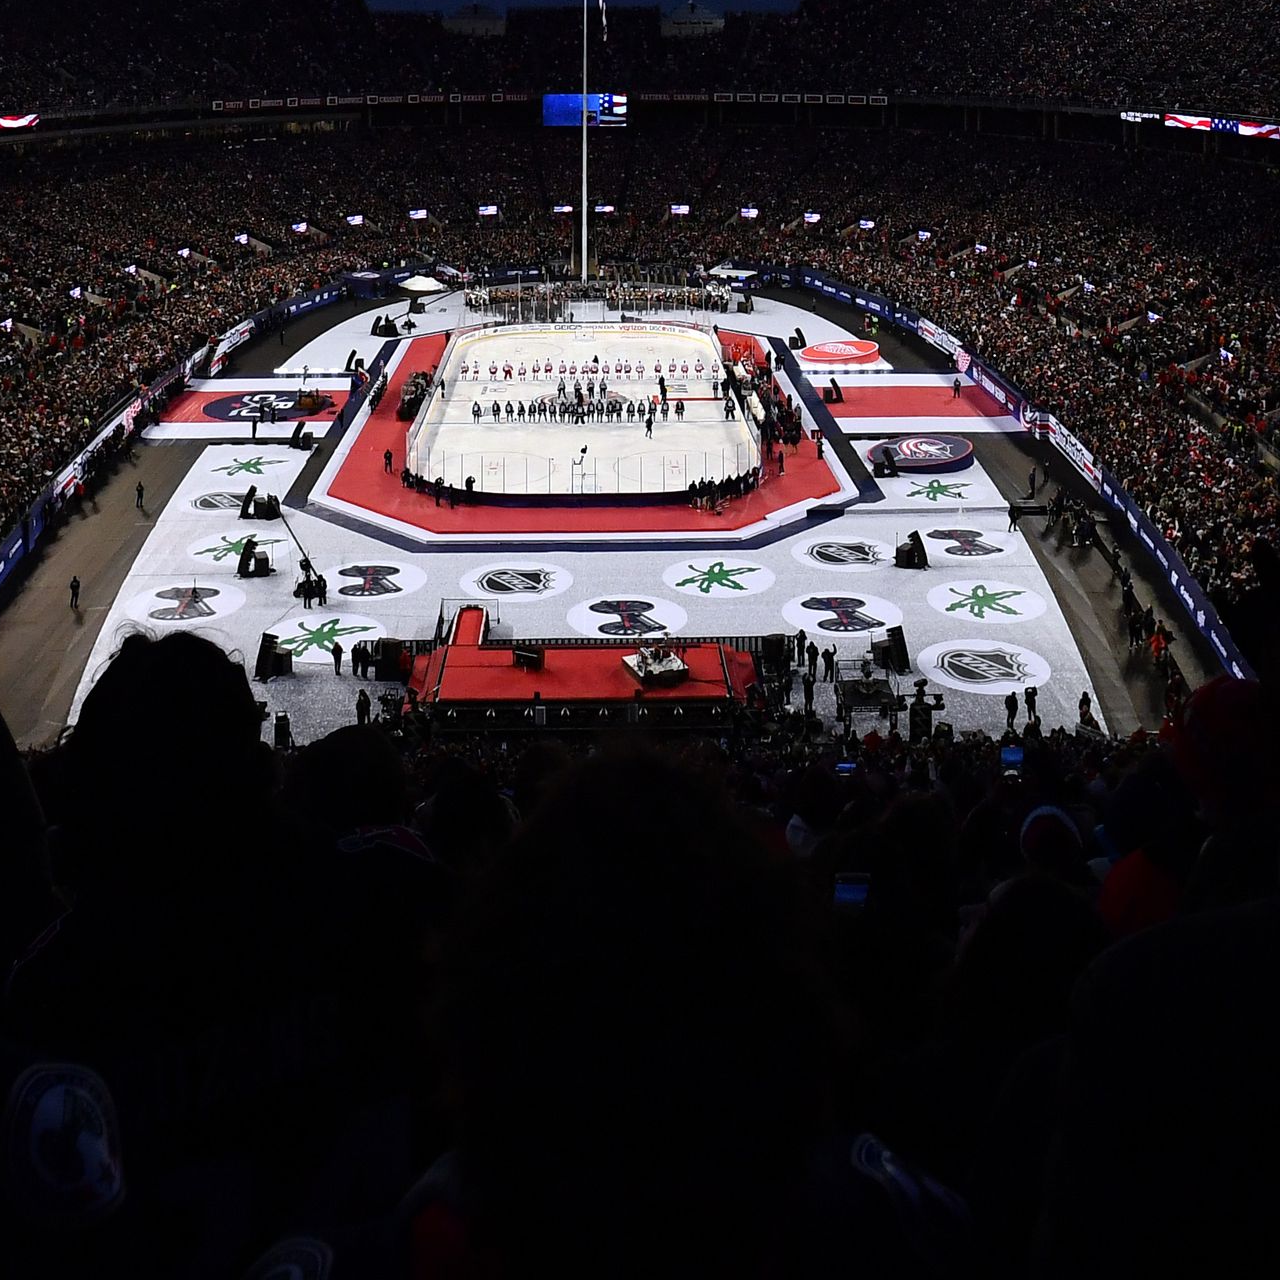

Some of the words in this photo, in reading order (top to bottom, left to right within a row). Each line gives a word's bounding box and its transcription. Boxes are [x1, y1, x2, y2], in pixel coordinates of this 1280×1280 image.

[619, 324, 647, 332] verizon
[495, 573, 534, 590] NHL
[952, 656, 1007, 677] NHL
